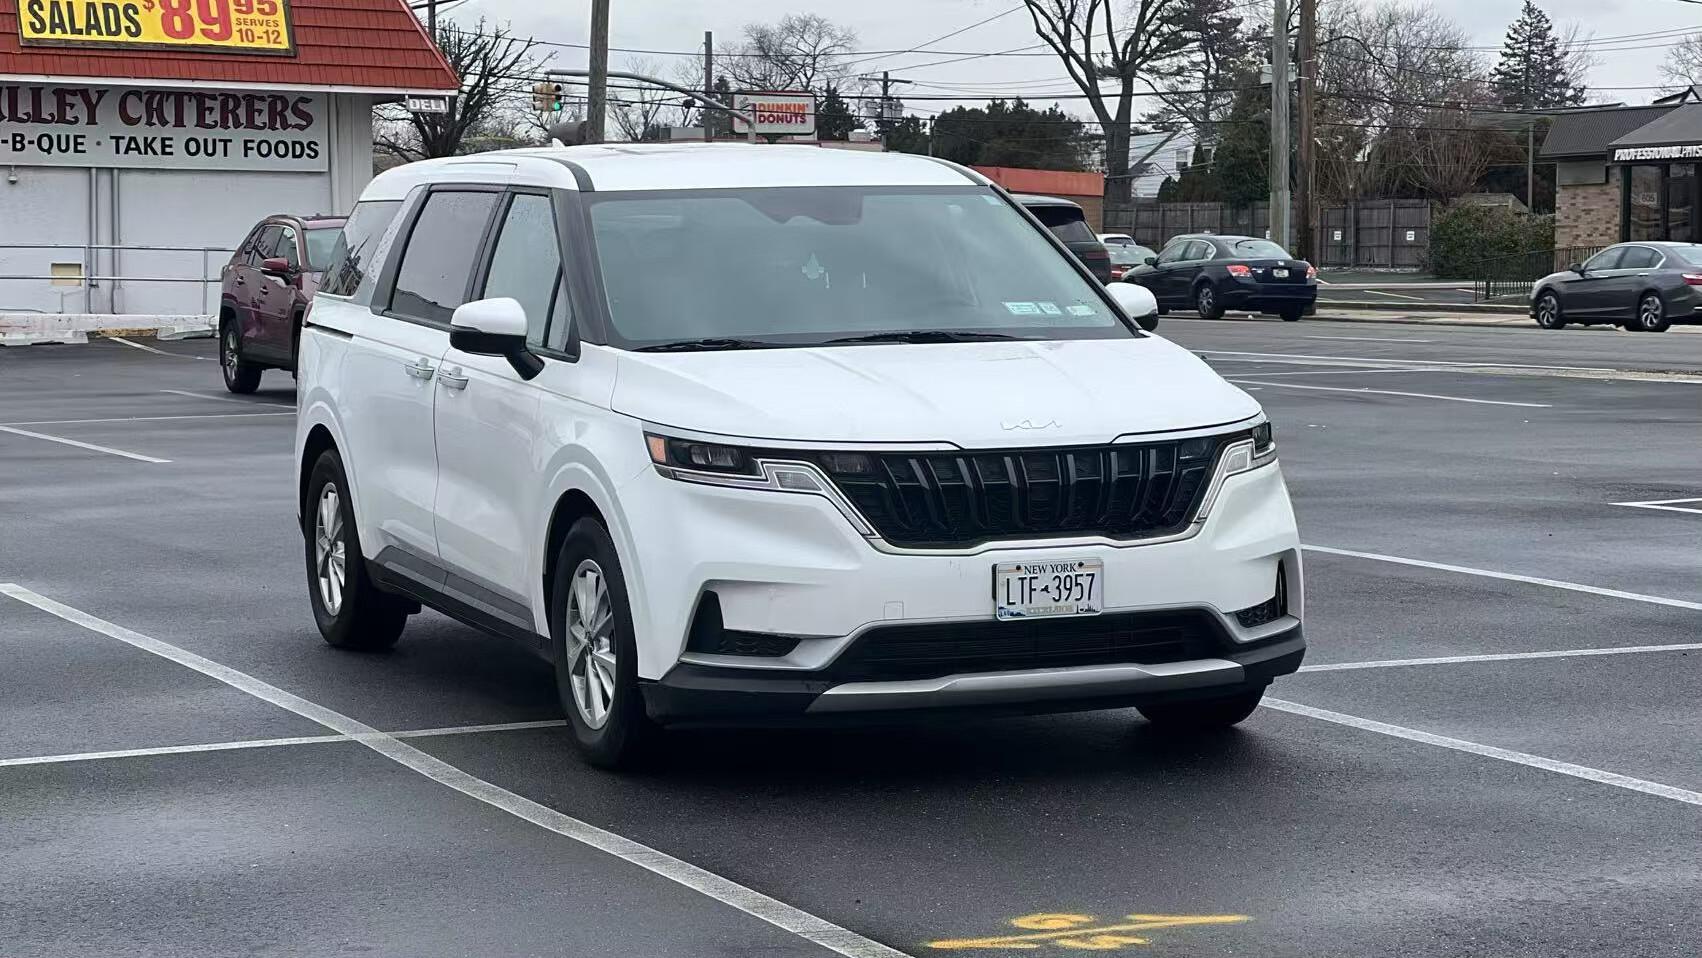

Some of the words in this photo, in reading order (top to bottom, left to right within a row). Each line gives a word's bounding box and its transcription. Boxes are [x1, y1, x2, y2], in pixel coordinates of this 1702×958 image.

[28, 0, 142, 38] SALADS
[235, 17, 280, 28] SERVES
[236, 28, 282, 44] 10-12
[118, 90, 314, 131] CATERERS
[409, 99, 446, 110] DELI
[758, 114, 807, 124] DONUTS
[110, 135, 174, 156] TAKE
[184, 138, 233, 158] OUT
[243, 139, 319, 159] FOODS
[1614, 145, 1682, 161] PROFESSIONAL
[1024, 565, 1047, 574] NEW
[1050, 563, 1077, 574] YORK
[1006, 576, 1039, 606] LTF
[1052, 573, 1096, 603] 3957
